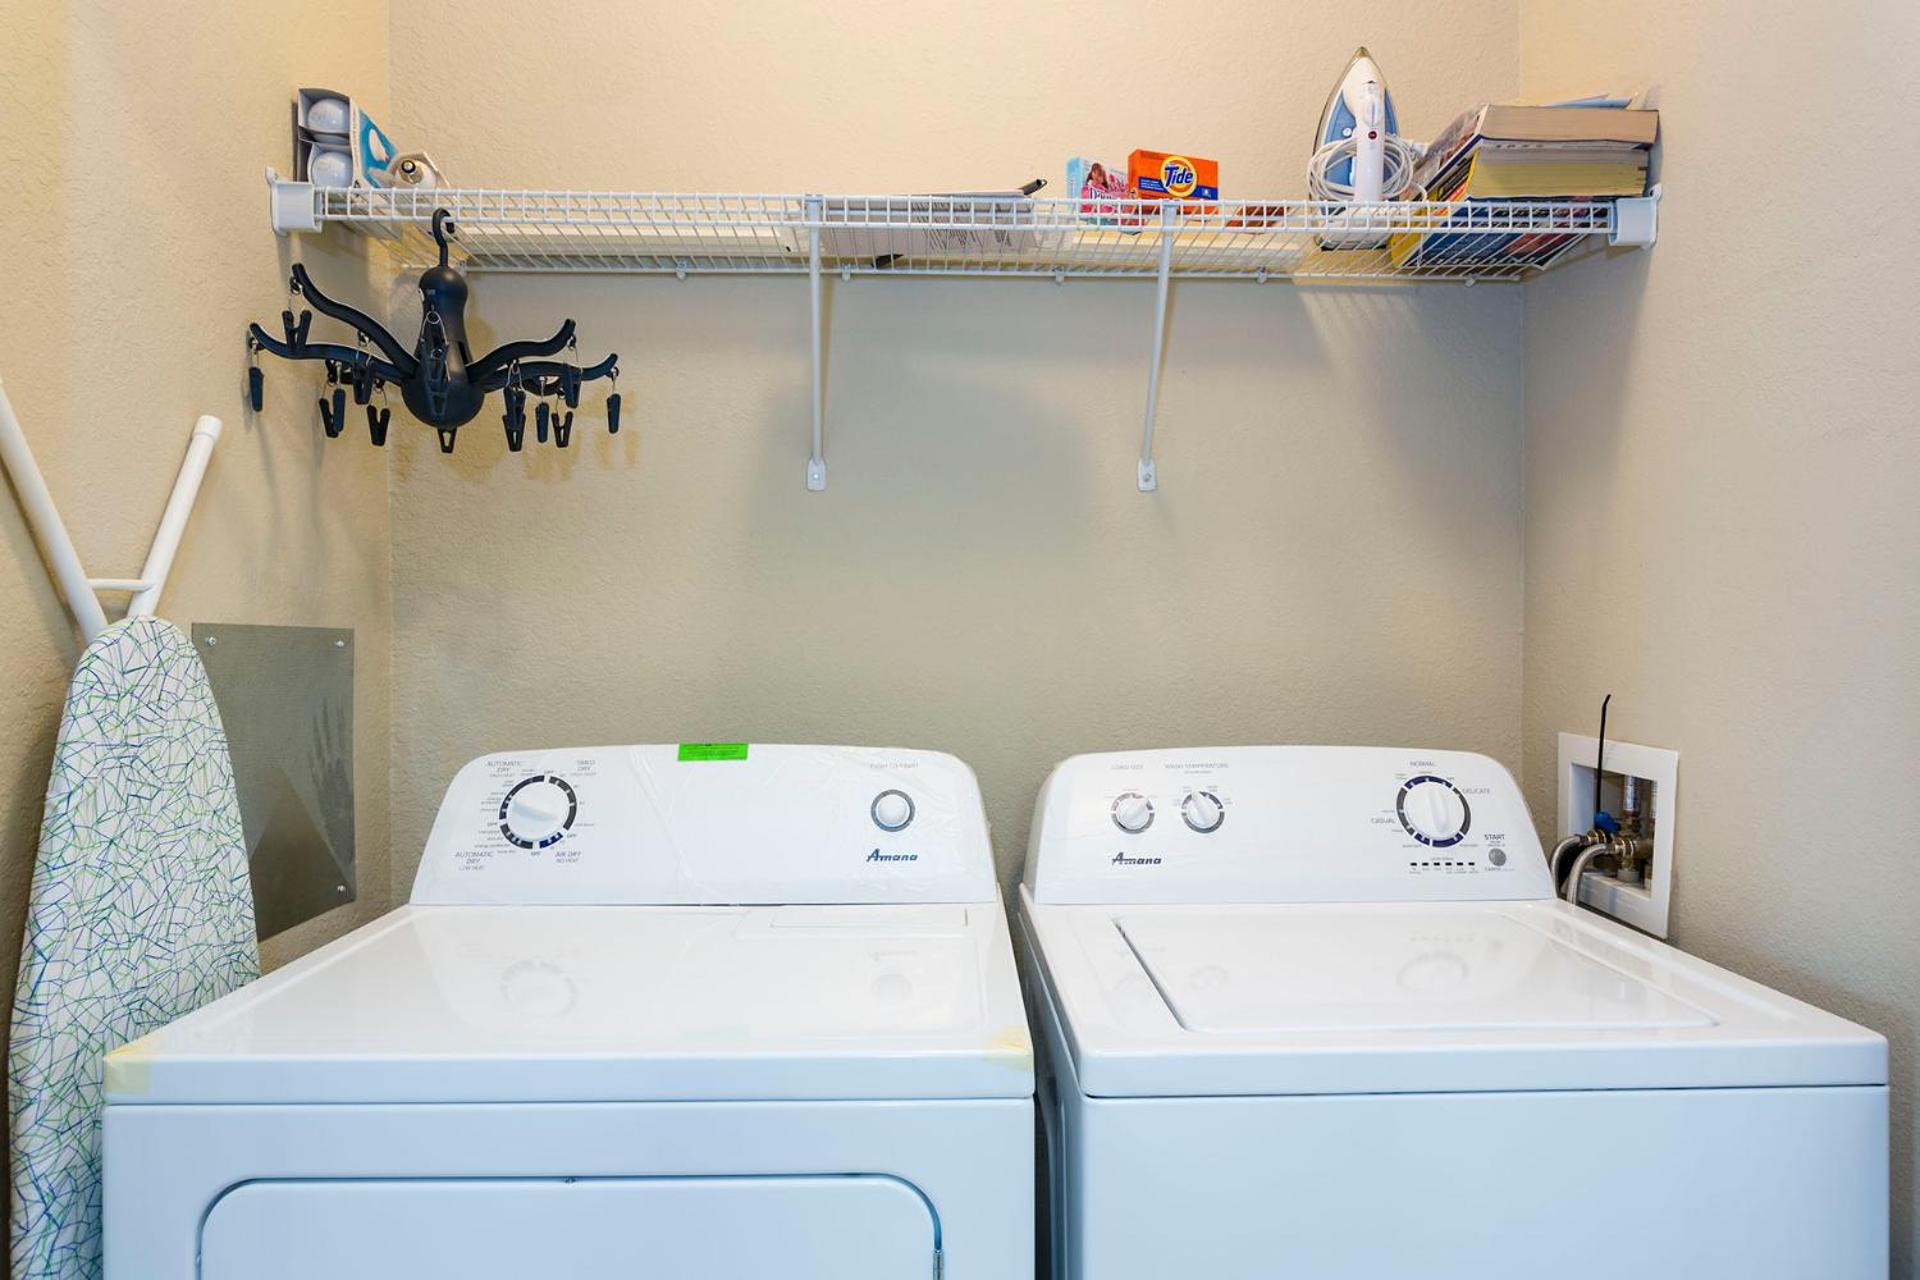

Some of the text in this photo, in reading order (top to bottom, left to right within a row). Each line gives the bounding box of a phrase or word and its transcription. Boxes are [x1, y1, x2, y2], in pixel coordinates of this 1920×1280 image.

[1164, 164, 1194, 187] Tide
[866, 848, 918, 862] Amana
[1112, 852, 1162, 865] Amana
